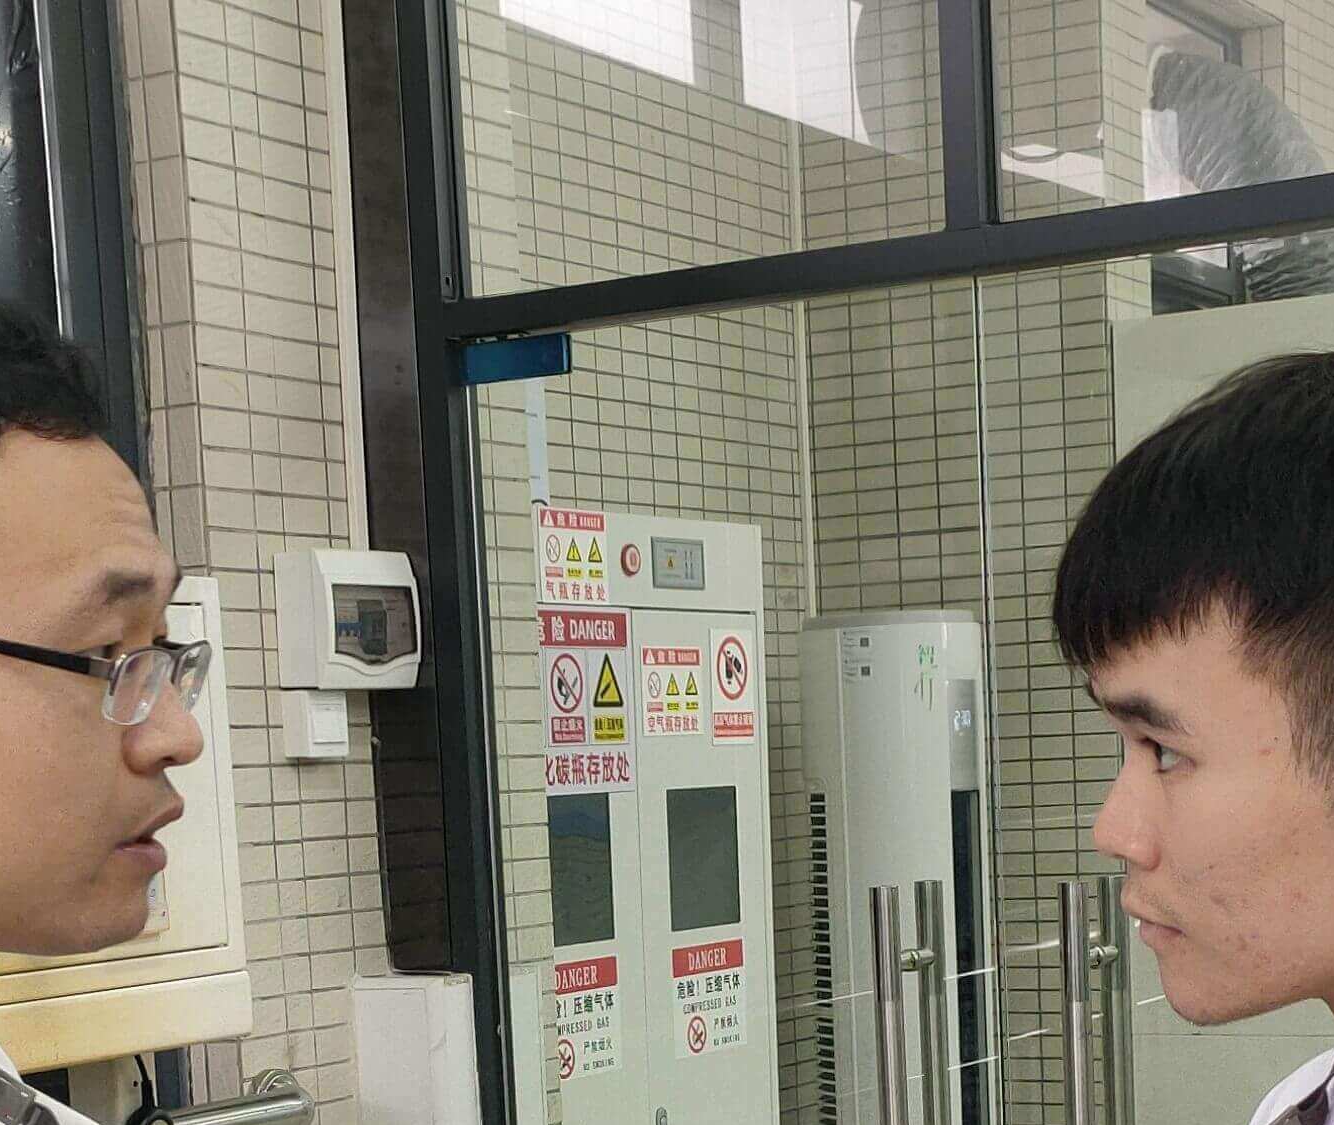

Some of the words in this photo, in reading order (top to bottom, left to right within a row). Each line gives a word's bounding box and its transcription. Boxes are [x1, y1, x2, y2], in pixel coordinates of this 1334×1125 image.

[546, 580, 606, 602] 气瓶存放处
[569, 618, 616, 641] DANGER
[687, 947, 727, 972] DANGER
[555, 965, 599, 991] DANGER
[597, 1016, 610, 1030] GAS
